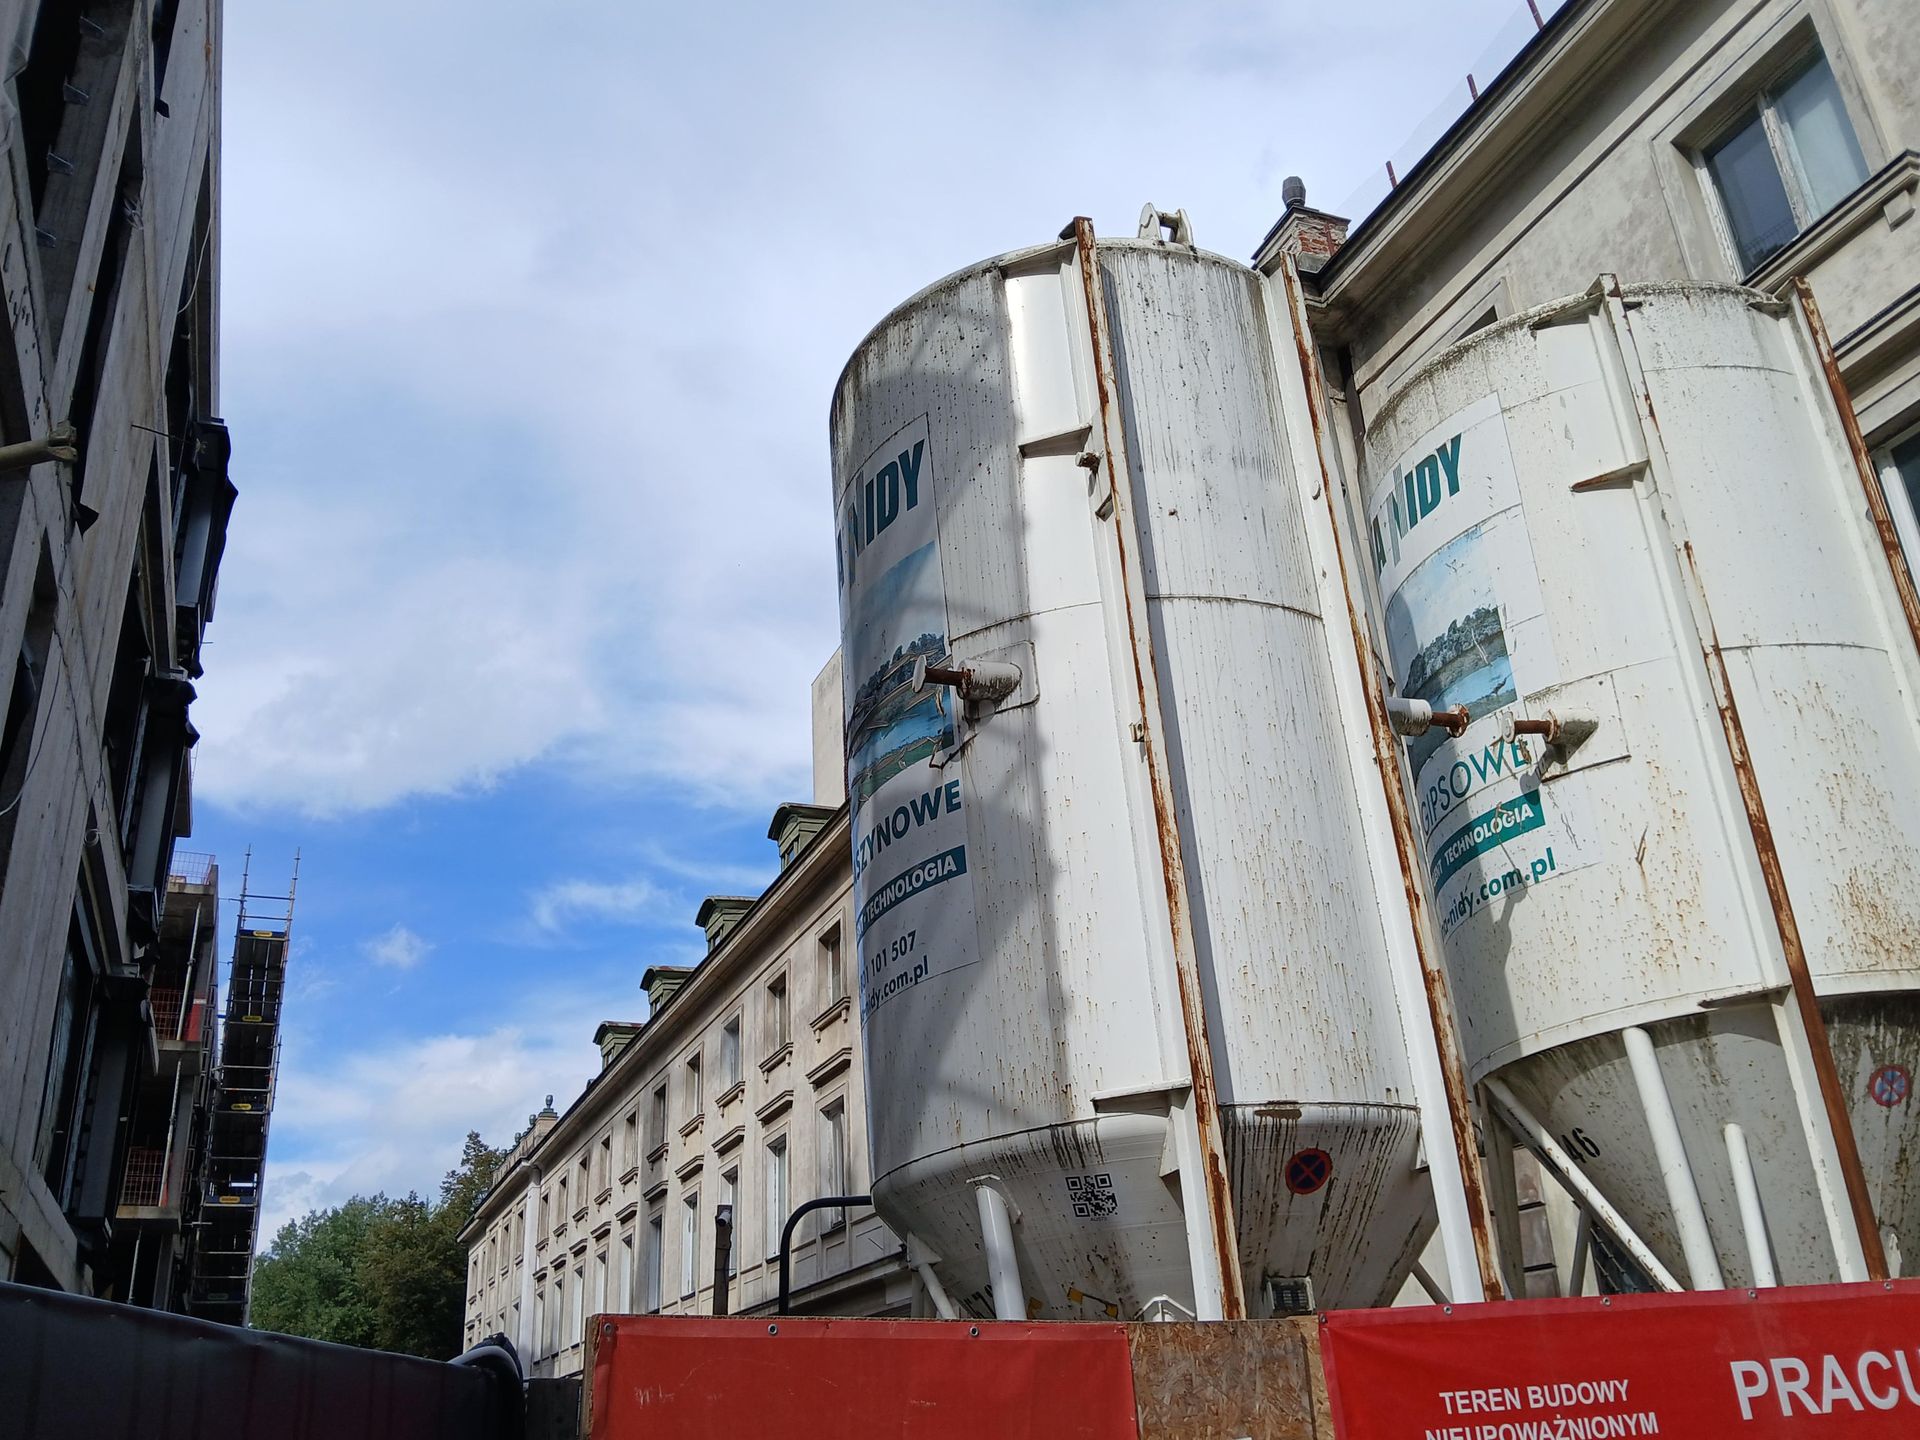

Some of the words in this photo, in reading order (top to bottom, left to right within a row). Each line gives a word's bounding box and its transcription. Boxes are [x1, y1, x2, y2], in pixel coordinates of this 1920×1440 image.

[1421, 737, 1530, 836] GIPSOWE
[1444, 803, 1535, 866] TECHNOLOGIA
[866, 854, 957, 924] TECHNOLOGIA
[871, 948, 887, 977] 101
[891, 929, 916, 962] 507
[1438, 1387, 1522, 1415] TEREN
[1526, 1378, 1629, 1409] BUDOWY
